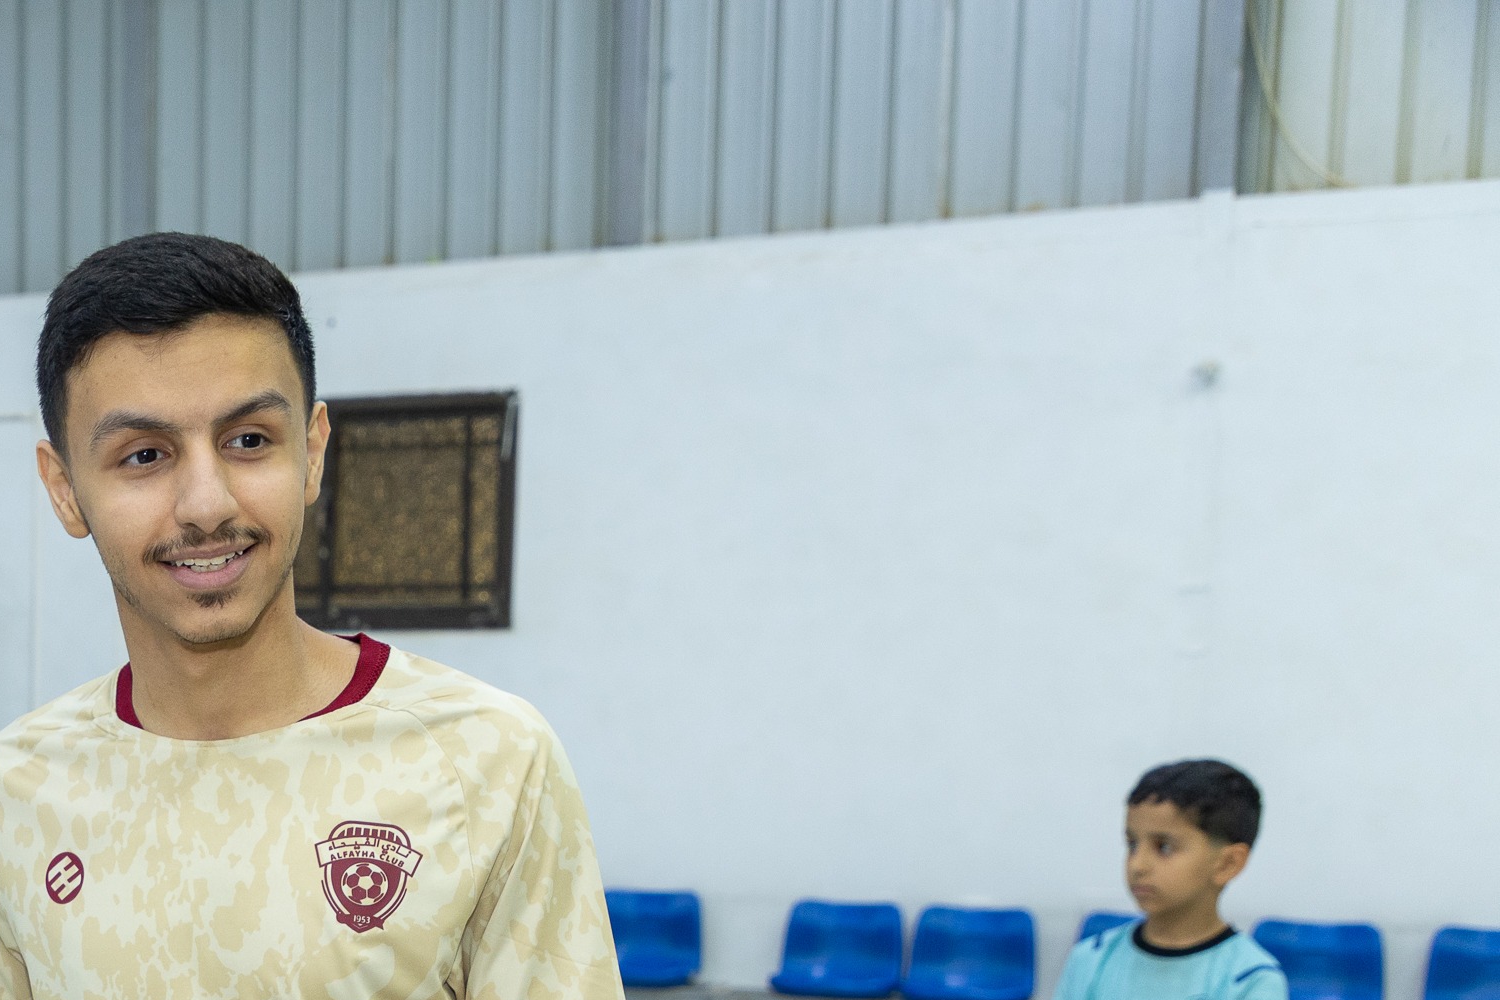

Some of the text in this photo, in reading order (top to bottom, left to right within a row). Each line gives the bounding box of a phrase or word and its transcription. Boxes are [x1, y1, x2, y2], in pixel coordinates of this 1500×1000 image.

[328, 837, 412, 858] نادي الفيحاء
[330, 850, 405, 868] ALFAYHA CLUB
[353, 915, 371, 924] 1953
